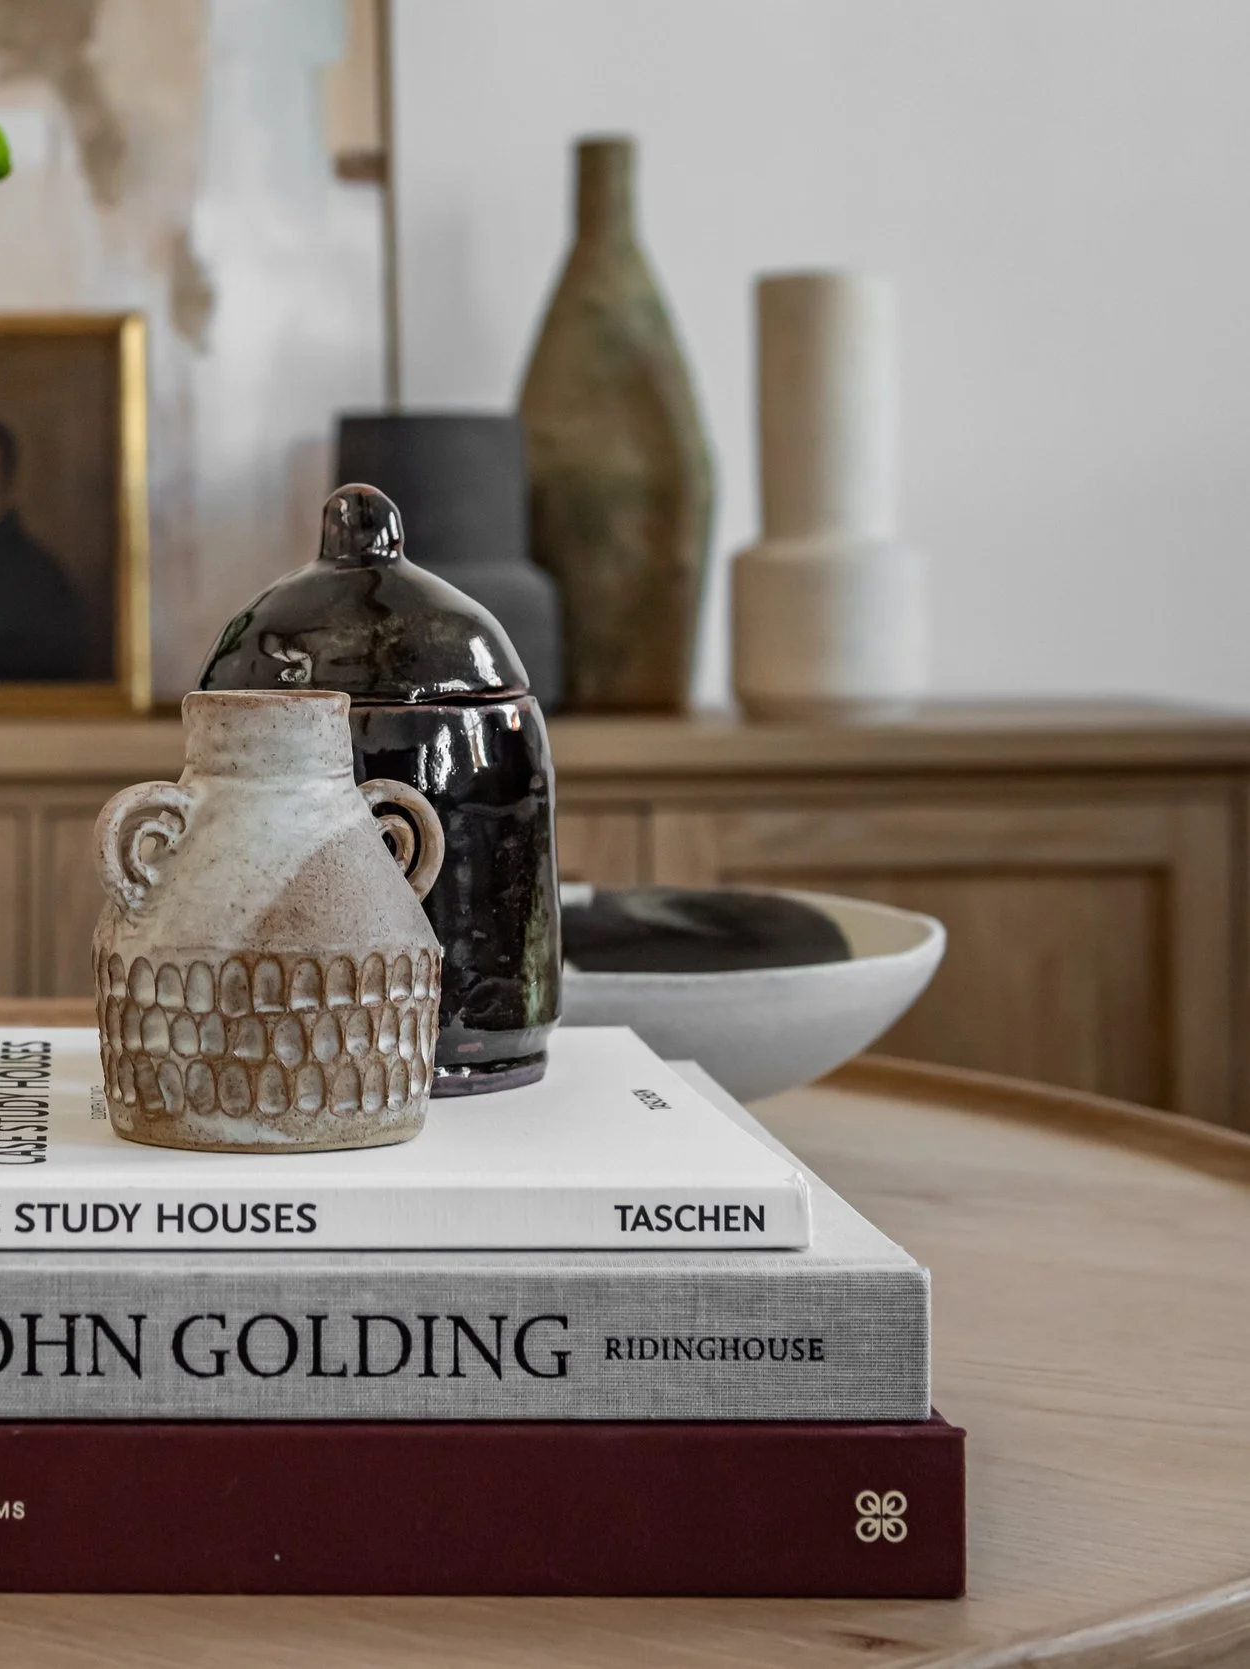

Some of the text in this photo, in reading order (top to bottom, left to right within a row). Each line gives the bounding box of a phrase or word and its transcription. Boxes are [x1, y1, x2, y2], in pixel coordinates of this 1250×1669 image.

[14, 1202, 143, 1233] STUDY
[157, 1202, 317, 1234] HOUSES
[613, 1204, 766, 1232] TASCHEN
[171, 1313, 572, 1381] GOLDING
[604, 1336, 827, 1363] RIDINGHOUSE
